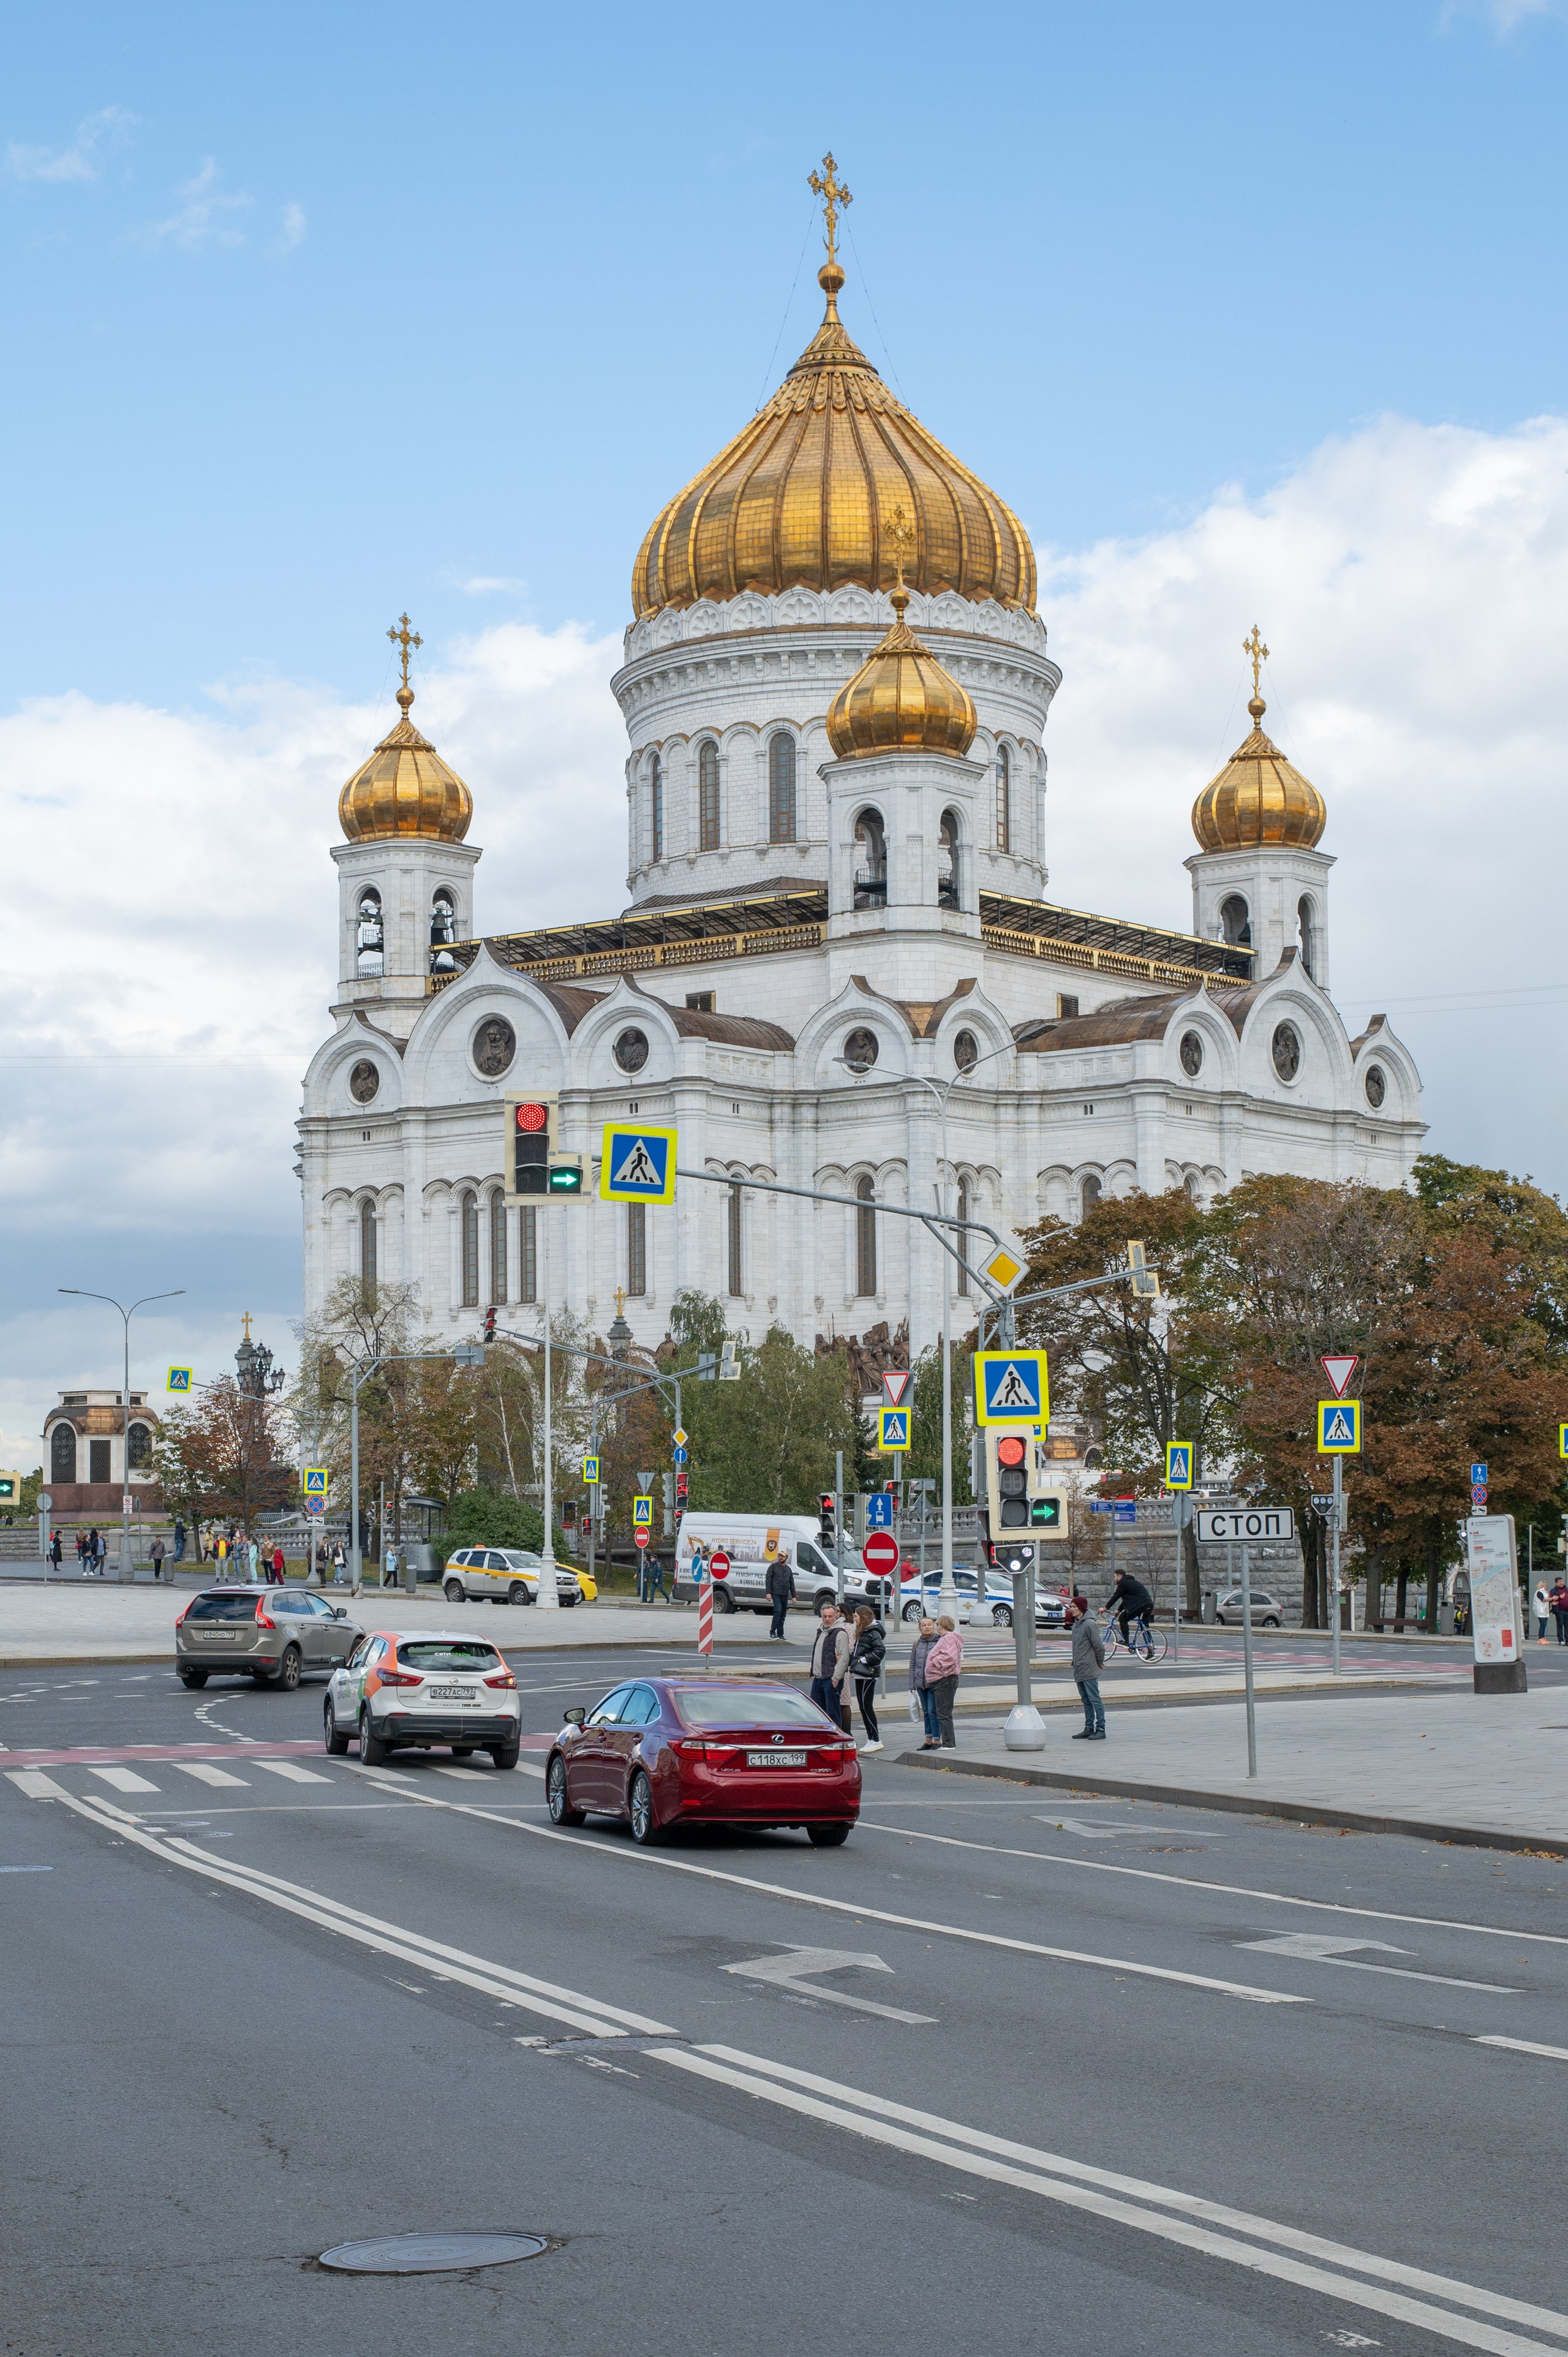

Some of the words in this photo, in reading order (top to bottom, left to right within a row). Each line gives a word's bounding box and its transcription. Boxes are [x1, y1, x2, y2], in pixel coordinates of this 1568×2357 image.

[677, 1485, 688, 1495] 24
[1211, 1514, 1280, 1537] СТОП
[750, 1754, 788, 1765] С118ХС
